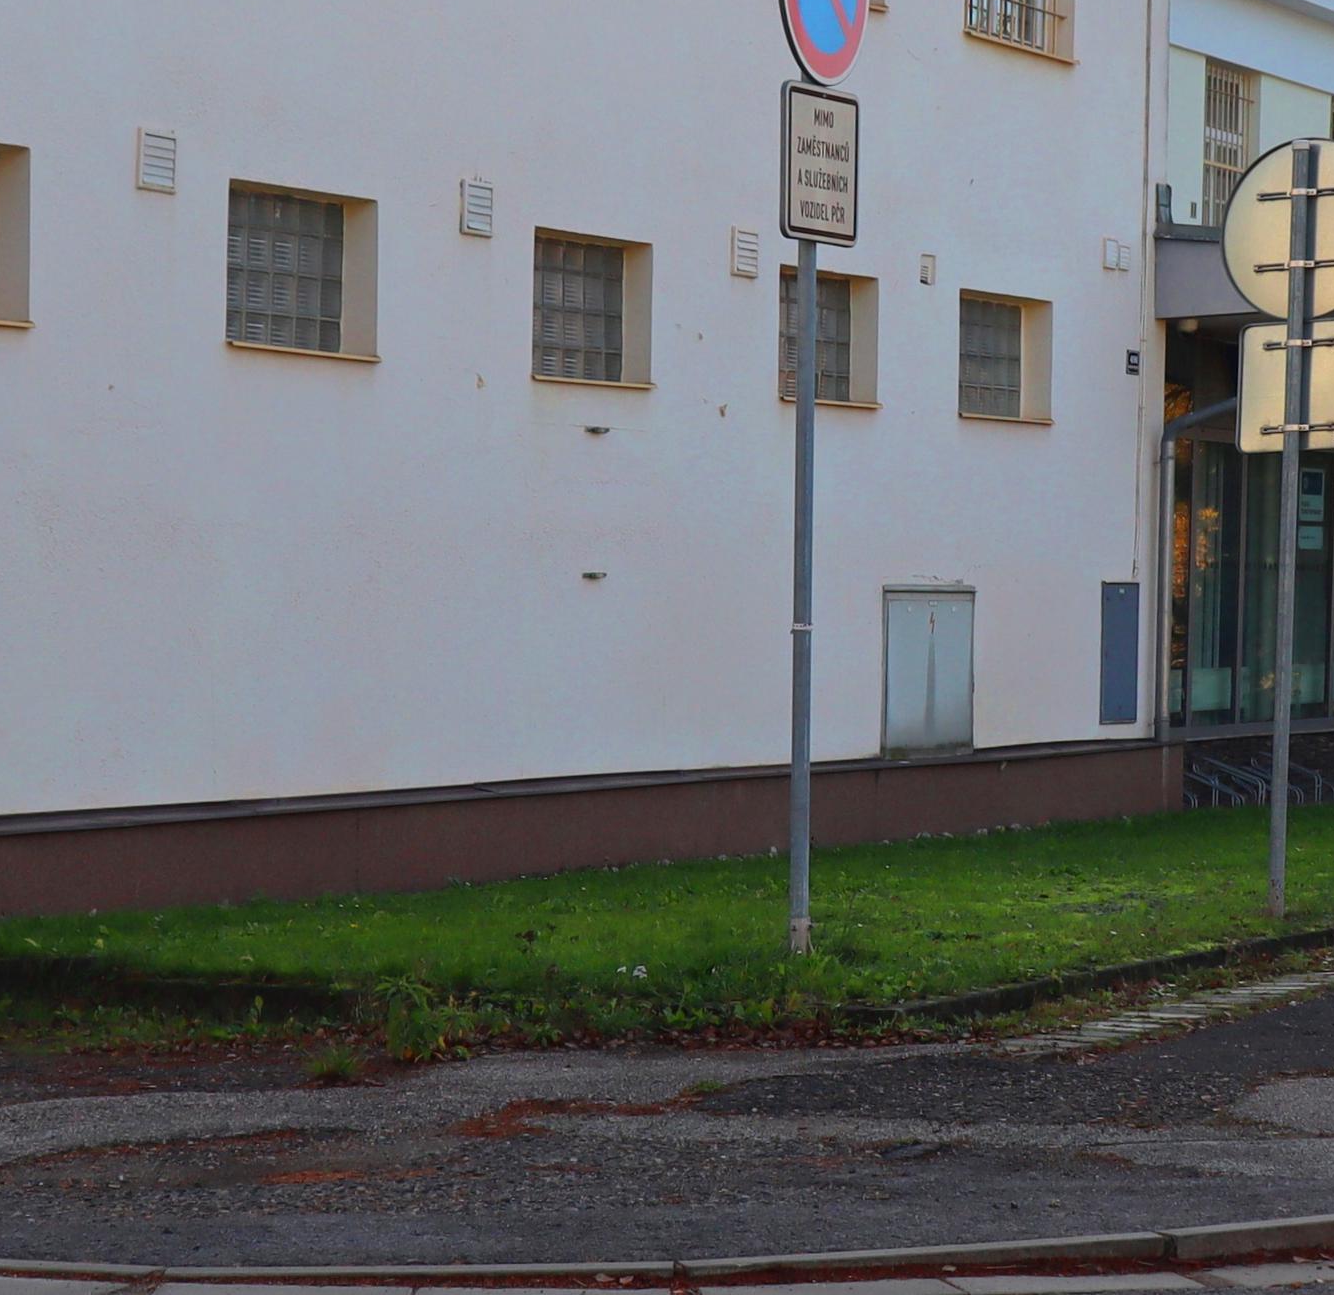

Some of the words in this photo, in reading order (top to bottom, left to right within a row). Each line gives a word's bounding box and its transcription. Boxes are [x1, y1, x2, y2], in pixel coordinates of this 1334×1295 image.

[814, 108, 834, 128] MIMO
[797, 135, 850, 163] ZAMĚSTNANCŮ
[797, 169, 804, 185] A
[804, 167, 849, 193] SLUŽEBNÍCH
[800, 199, 829, 221] VOZIDEL
[831, 203, 845, 224] PČR
